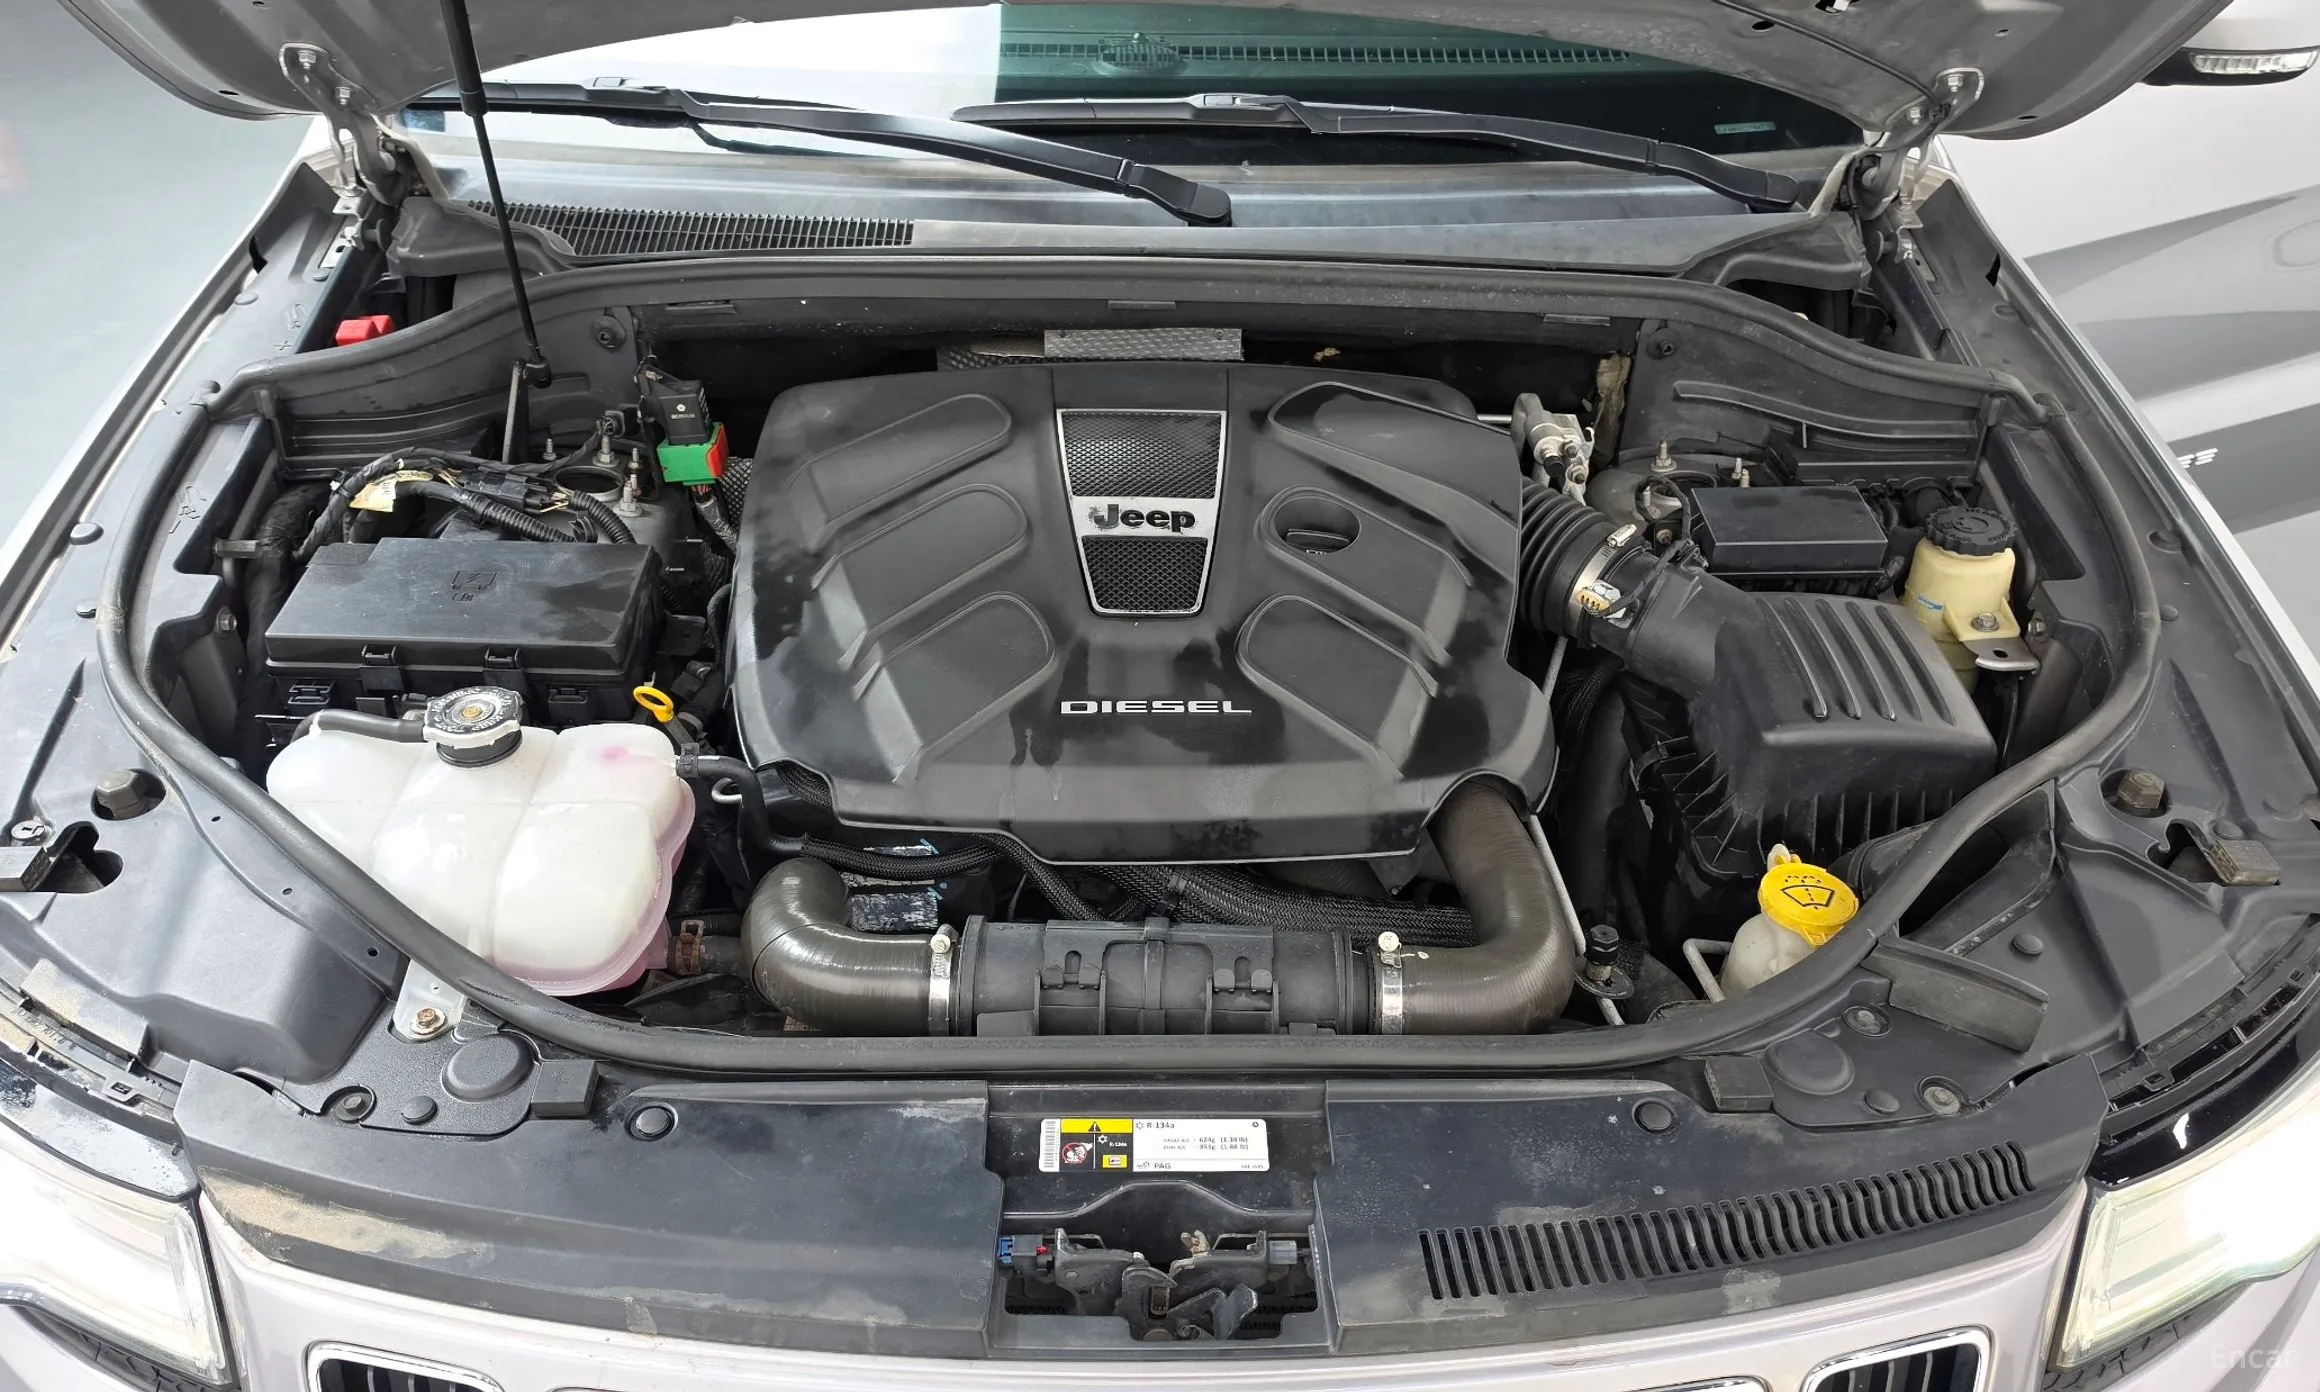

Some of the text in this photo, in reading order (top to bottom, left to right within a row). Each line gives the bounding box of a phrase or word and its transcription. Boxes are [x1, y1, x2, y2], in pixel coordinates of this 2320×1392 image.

[1092, 503, 1196, 533] Jeep
[1060, 700, 1252, 714] DIESEL
[1146, 1121, 1175, 1129] R-134a
[1154, 1162, 1172, 1170] PAG
